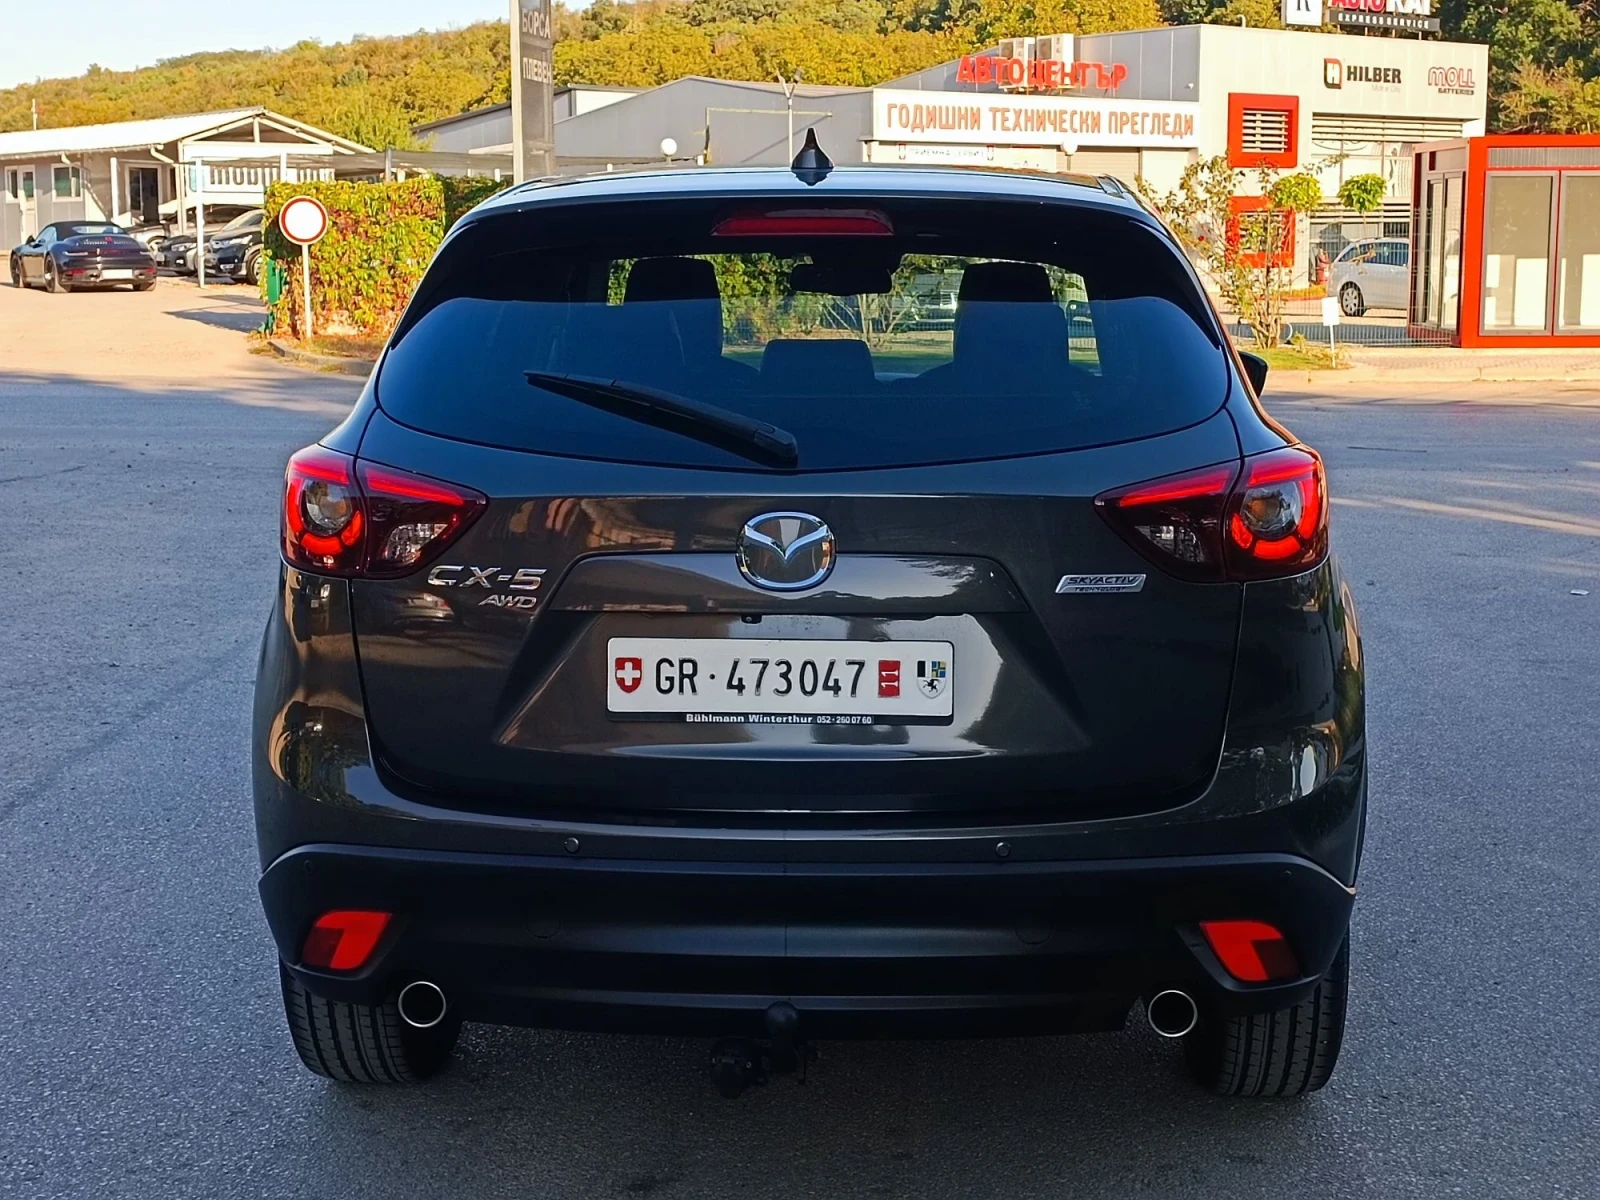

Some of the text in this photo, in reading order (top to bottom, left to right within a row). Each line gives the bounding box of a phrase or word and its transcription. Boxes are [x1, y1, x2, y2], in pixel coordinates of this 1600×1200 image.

[522, 7, 551, 39] БОРСА
[1337, 12, 1430, 29] EXPRESS SERVICE
[522, 56, 552, 84] ПЛЕВЕН
[956, 55, 1128, 90] АВТОЦЕНТЪР
[1347, 65, 1402, 84] HILBER
[1428, 66, 1475, 88] MOLL
[887, 103, 1194, 140] ГОДИШНИ ТЕХНИЧЕСКИ ПРЕГЛЕДИ
[427, 565, 547, 591] CX-5
[1068, 576, 1138, 585] SKYACTIV
[478, 594, 537, 609] AWD
[686, 713, 745, 723] Bühlmann
[749, 714, 813, 724] Winterthur
